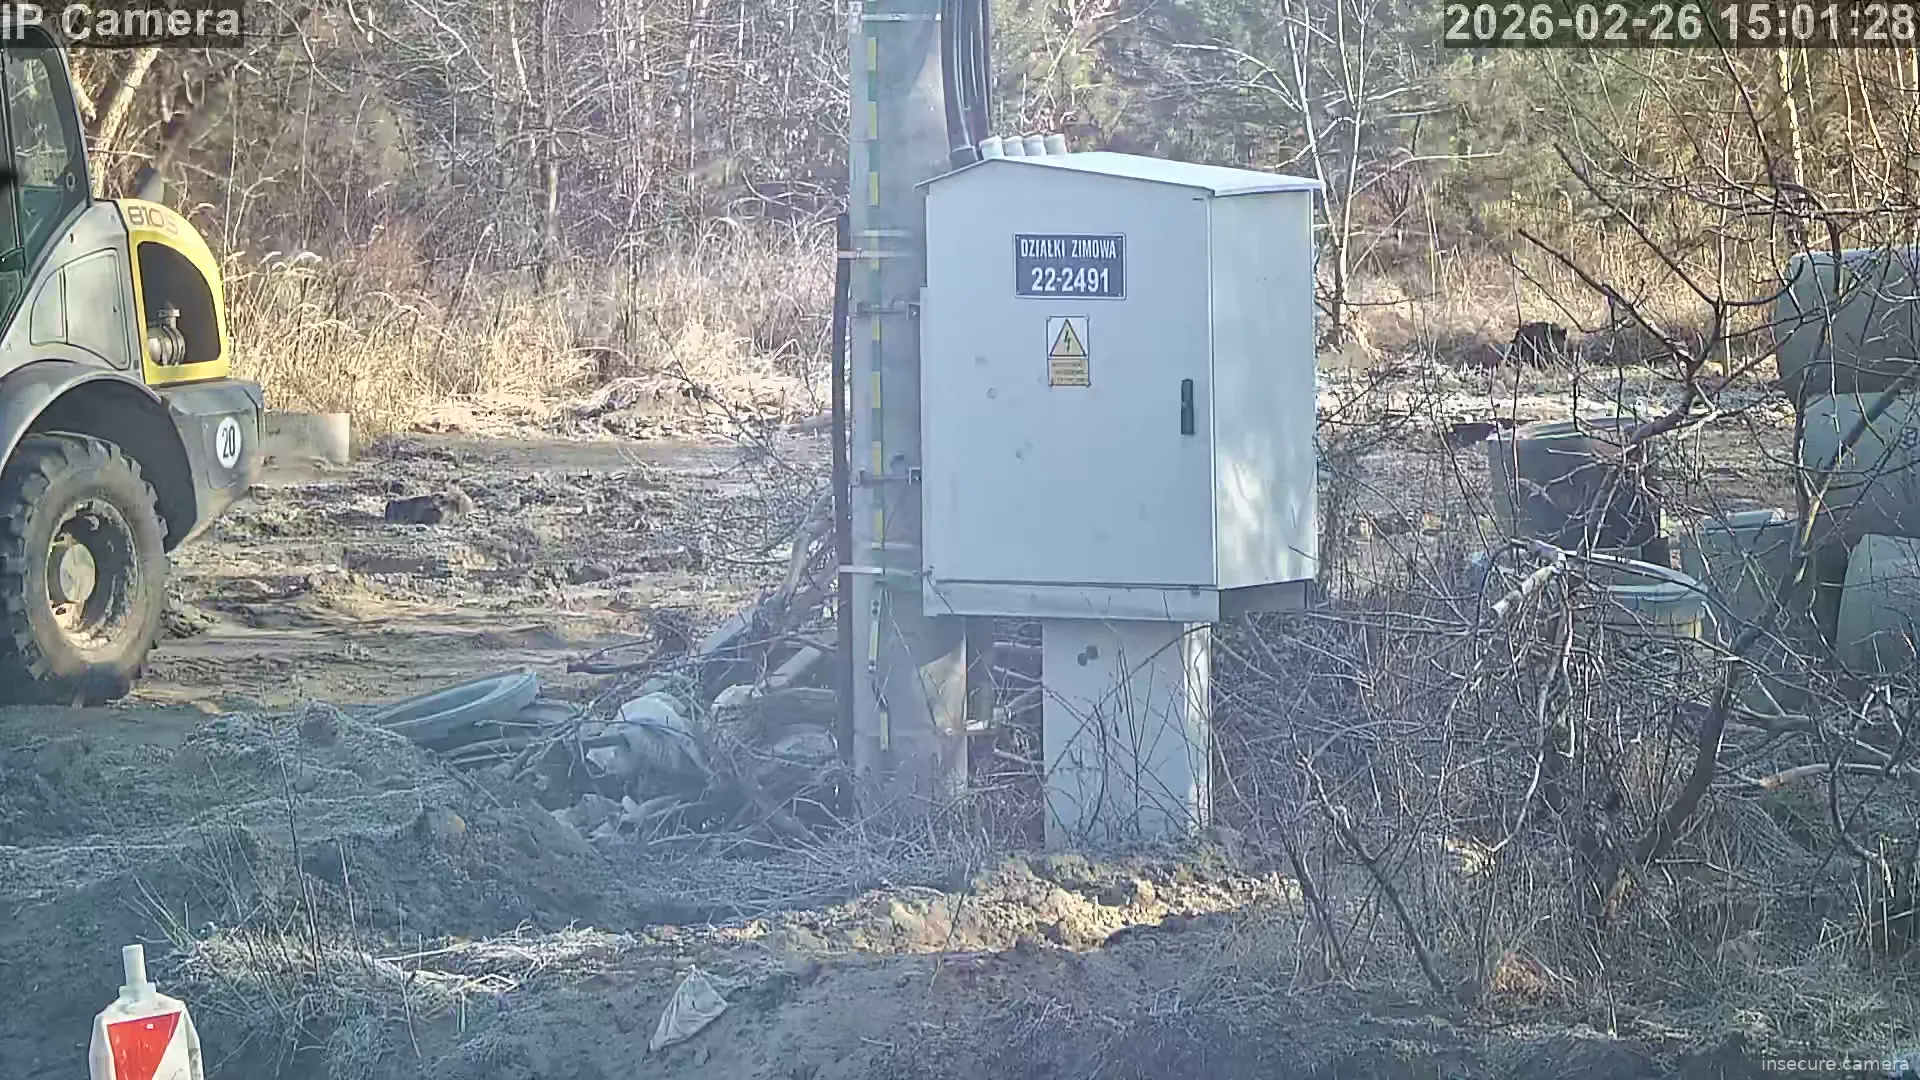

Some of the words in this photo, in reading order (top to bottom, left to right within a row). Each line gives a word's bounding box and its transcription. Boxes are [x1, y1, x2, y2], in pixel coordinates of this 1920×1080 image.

[1020, 239, 1065, 258] DZIAŁKI
[1071, 239, 1116, 259] ZIMOWA
[1031, 267, 1109, 293] 22-2491
[221, 425, 236, 459] 20
